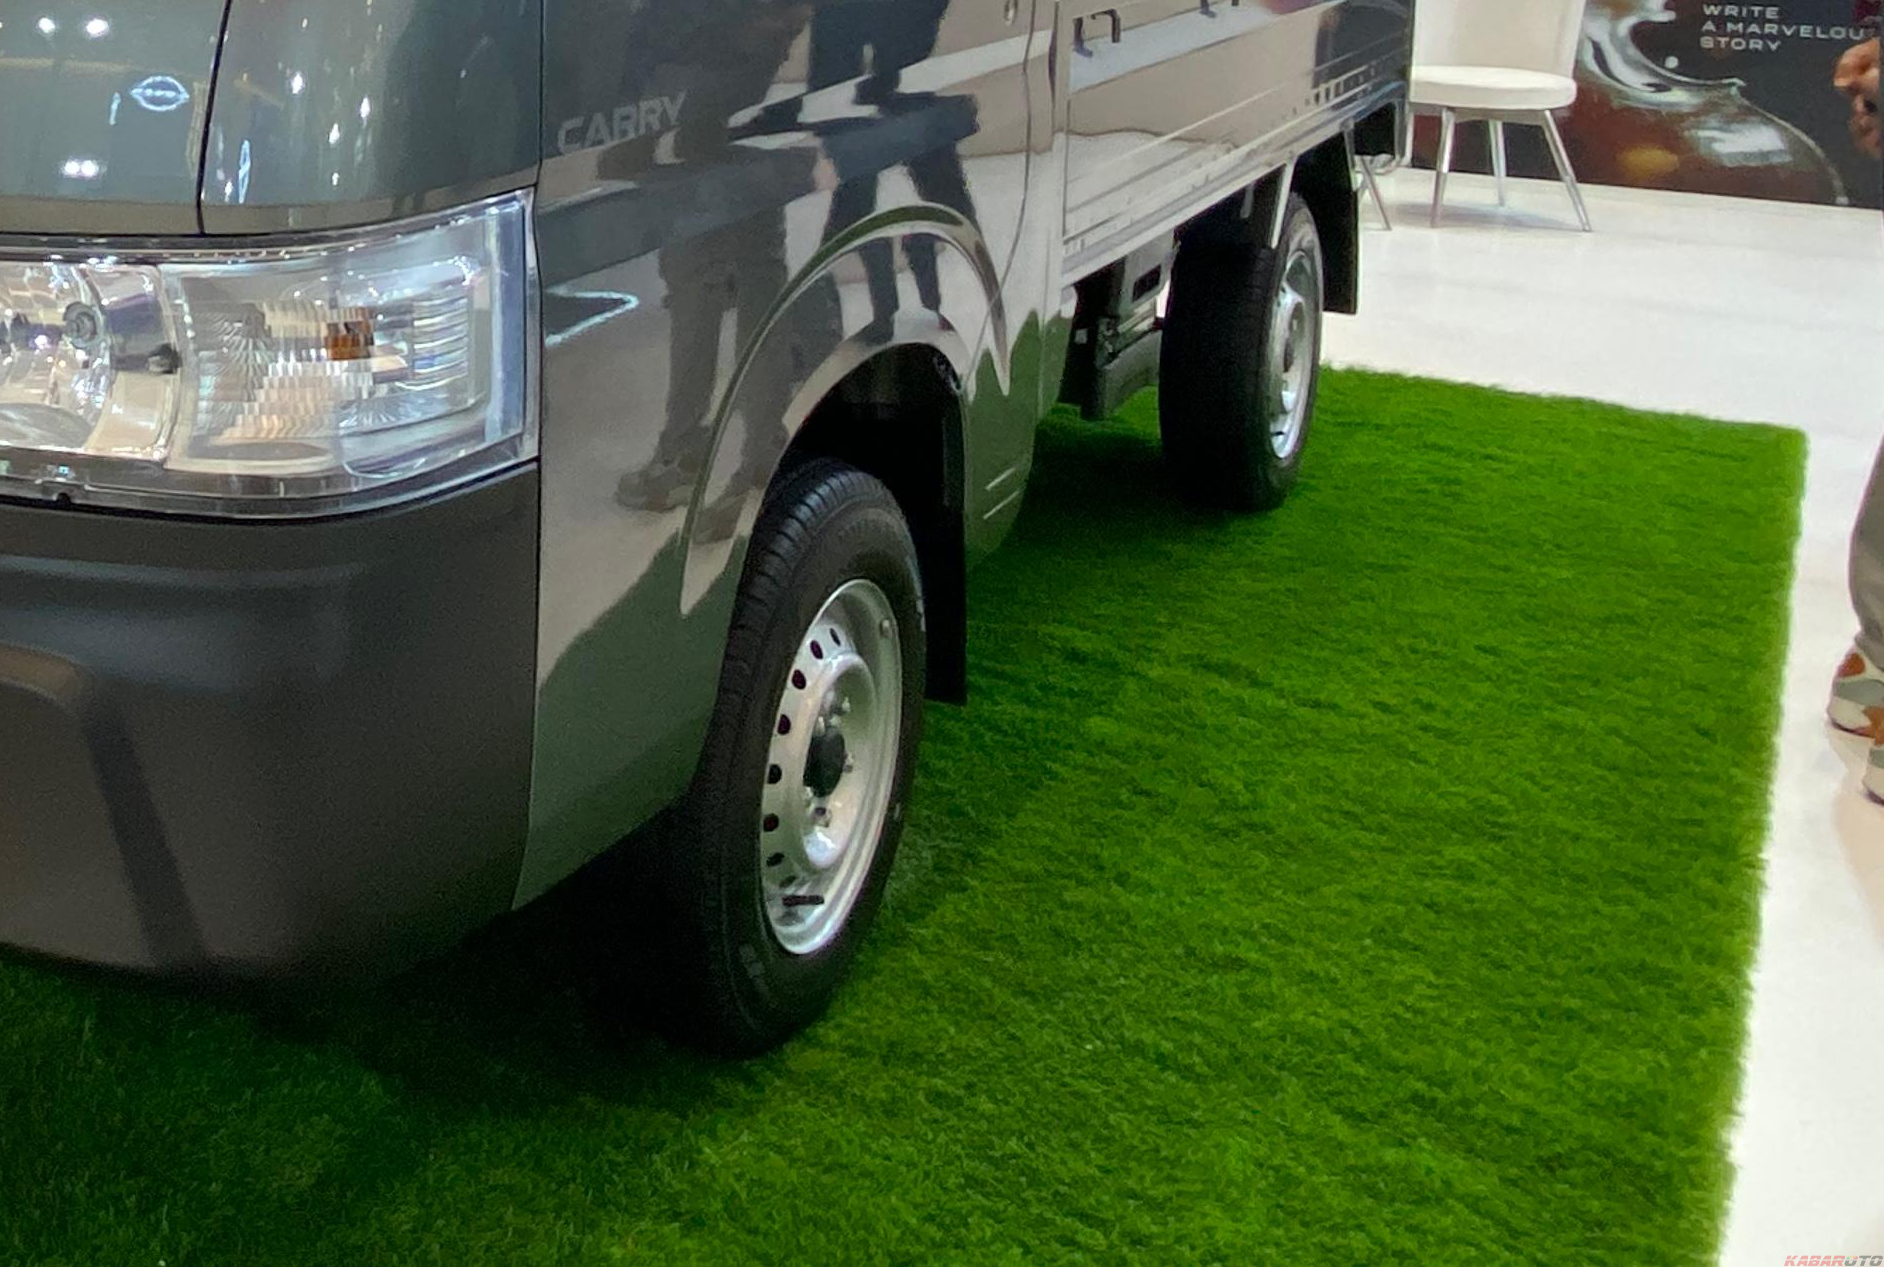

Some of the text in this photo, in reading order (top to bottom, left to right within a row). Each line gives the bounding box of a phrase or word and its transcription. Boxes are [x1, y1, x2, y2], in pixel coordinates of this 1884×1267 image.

[1702, 3, 1781, 19] WRITE
[1701, 20, 1874, 40] A MARVELOU
[1699, 36, 1781, 51] STORY
[556, 88, 688, 154] CARRY
